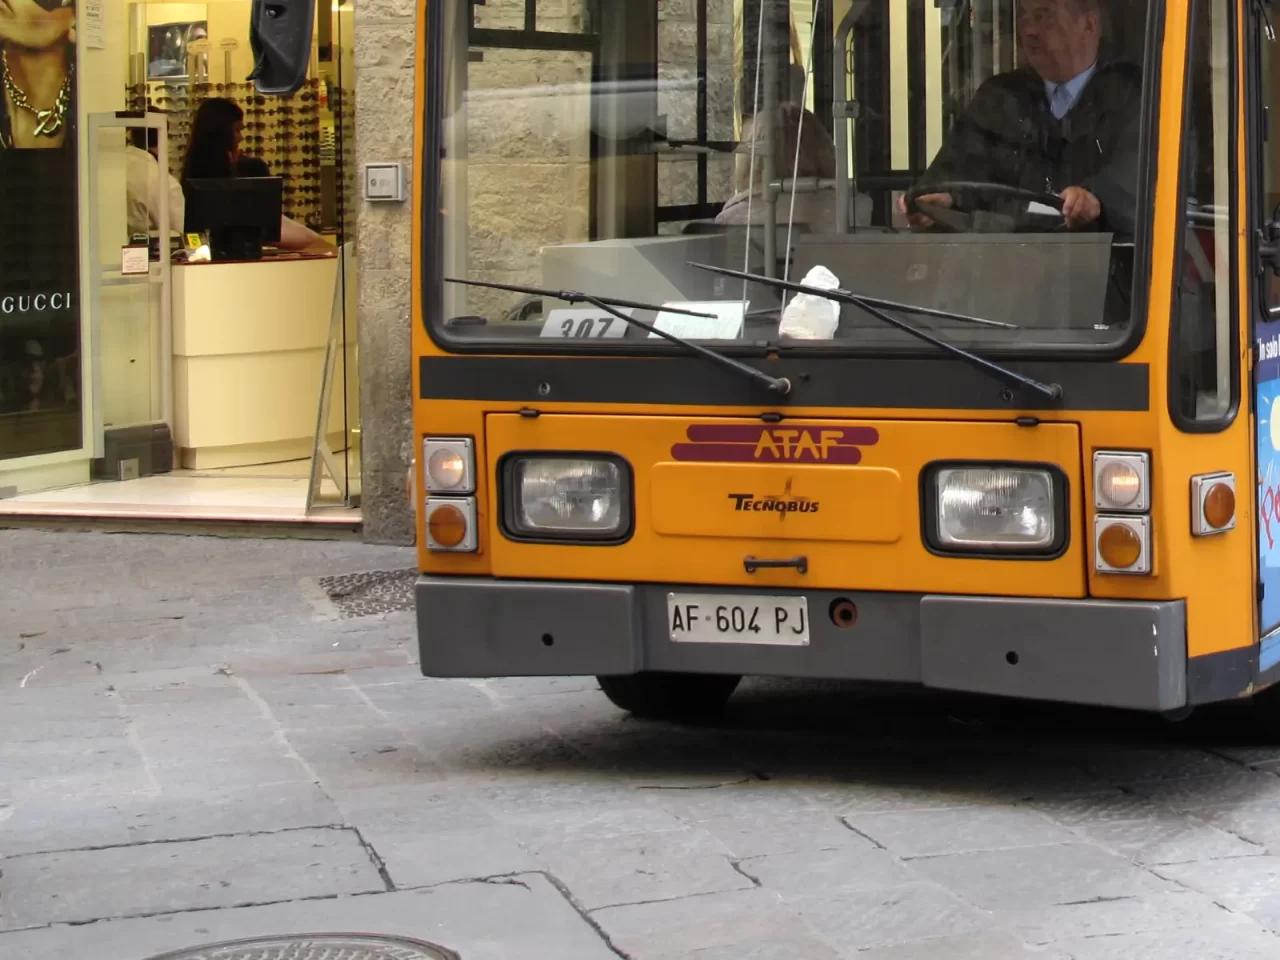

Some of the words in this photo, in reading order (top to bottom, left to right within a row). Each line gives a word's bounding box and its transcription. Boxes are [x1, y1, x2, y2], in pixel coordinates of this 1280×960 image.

[1, 292, 71, 314] GUCCI
[560, 316, 615, 338] 307
[1266, 334, 1278, 359] solo
[753, 429, 844, 459] ATAF
[728, 493, 820, 513] TECNOBUS
[672, 604, 699, 632] AF
[716, 605, 762, 634] 604
[775, 606, 805, 635] PJ
